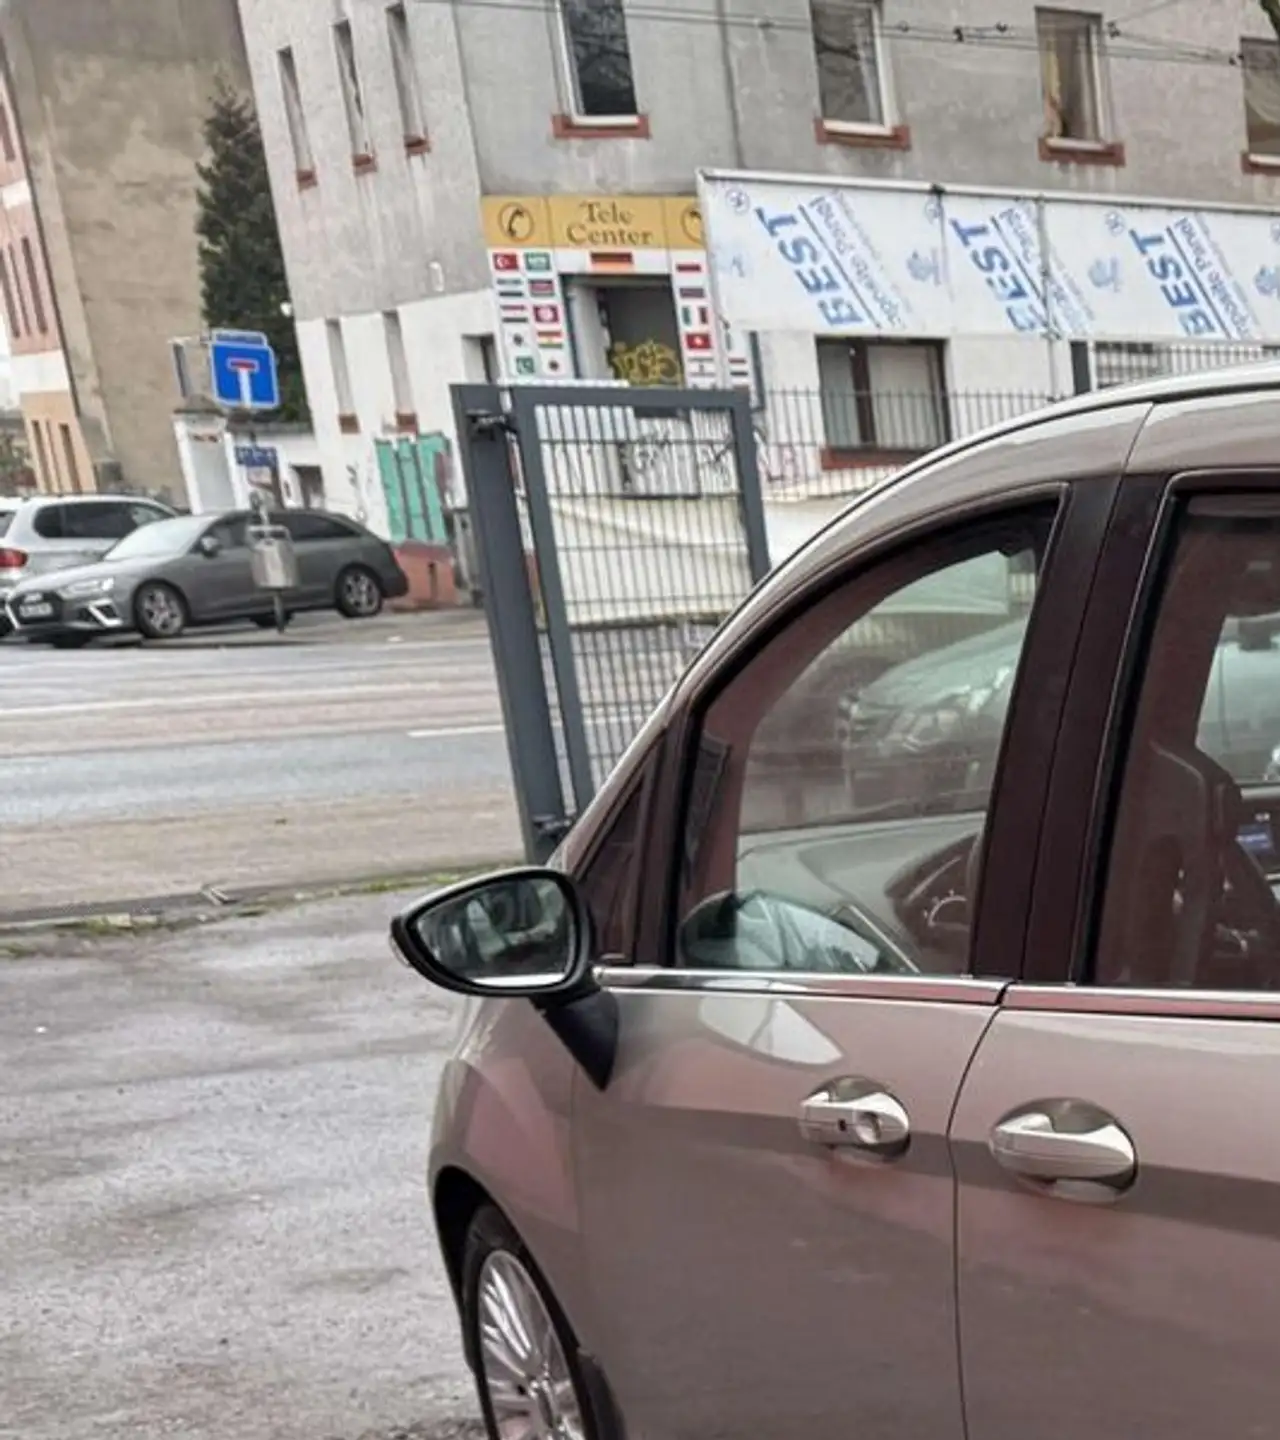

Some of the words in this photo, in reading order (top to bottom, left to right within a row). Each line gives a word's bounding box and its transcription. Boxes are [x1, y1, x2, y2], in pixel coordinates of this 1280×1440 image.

[566, 222, 653, 246] Center
[579, 200, 634, 225] Tele
[755, 207, 863, 327] BEST
[1128, 229, 1217, 338] BEST
